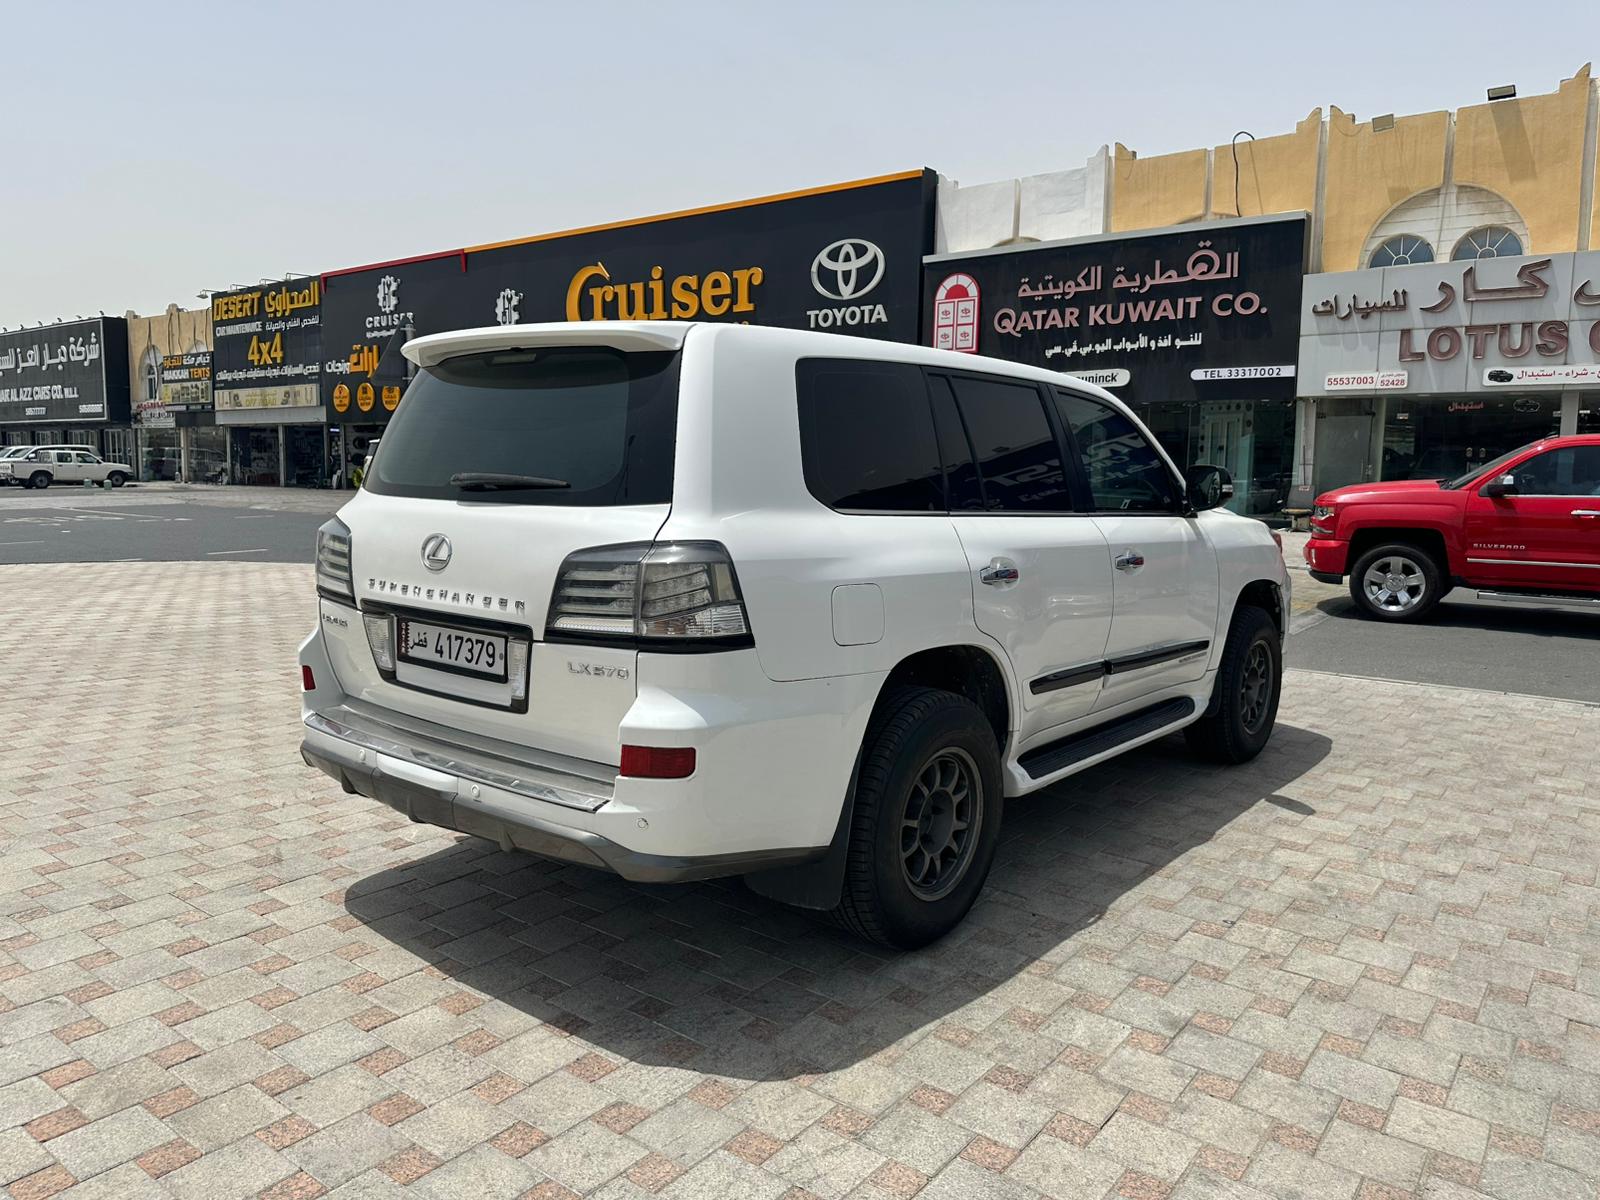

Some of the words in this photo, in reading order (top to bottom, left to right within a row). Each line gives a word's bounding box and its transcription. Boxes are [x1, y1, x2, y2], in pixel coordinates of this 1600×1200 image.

[1017, 265, 1102, 300] الكويتية
[1112, 240, 1239, 293] القطرية
[264, 281, 320, 318] الصحراوي
[566, 261, 763, 322] Cruiser
[1419, 258, 1552, 313] كار
[213, 291, 262, 321] DESERT
[806, 304, 889, 329] TOYOTA
[993, 307, 1080, 337] QATAR
[1088, 296, 1202, 327] KUWAIT
[1211, 291, 1269, 317] CO.
[1311, 288, 1409, 321] للسيارات
[69, 332, 100, 367] شركة
[1399, 321, 1569, 362] LOTUS
[1327, 376, 1375, 386] 55537003
[1380, 379, 1406, 387] 52428
[1517, 370, 1556, 381] استبدال
[1565, 368, 1588, 378] شراء
[410, 632, 428, 650] قطر
[434, 632, 496, 668] 417379
